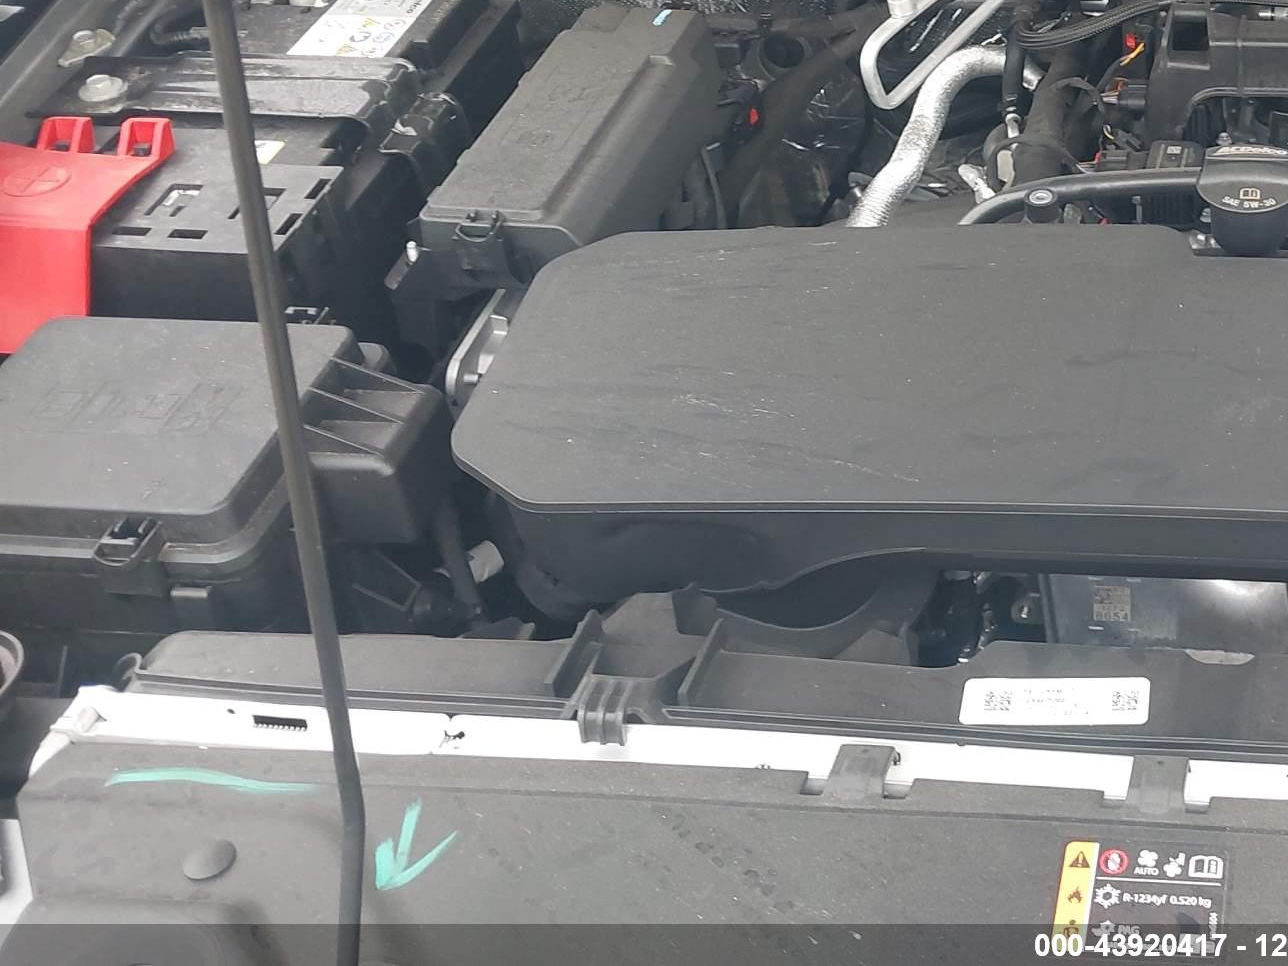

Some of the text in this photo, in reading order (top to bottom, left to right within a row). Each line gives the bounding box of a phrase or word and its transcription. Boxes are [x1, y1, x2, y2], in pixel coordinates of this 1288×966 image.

[1221, 195, 1276, 209] SAE 5W-30
[1133, 866, 1160, 876] AUTO
[1122, 893, 1212, 909] R-1234yf 0.520 kg
